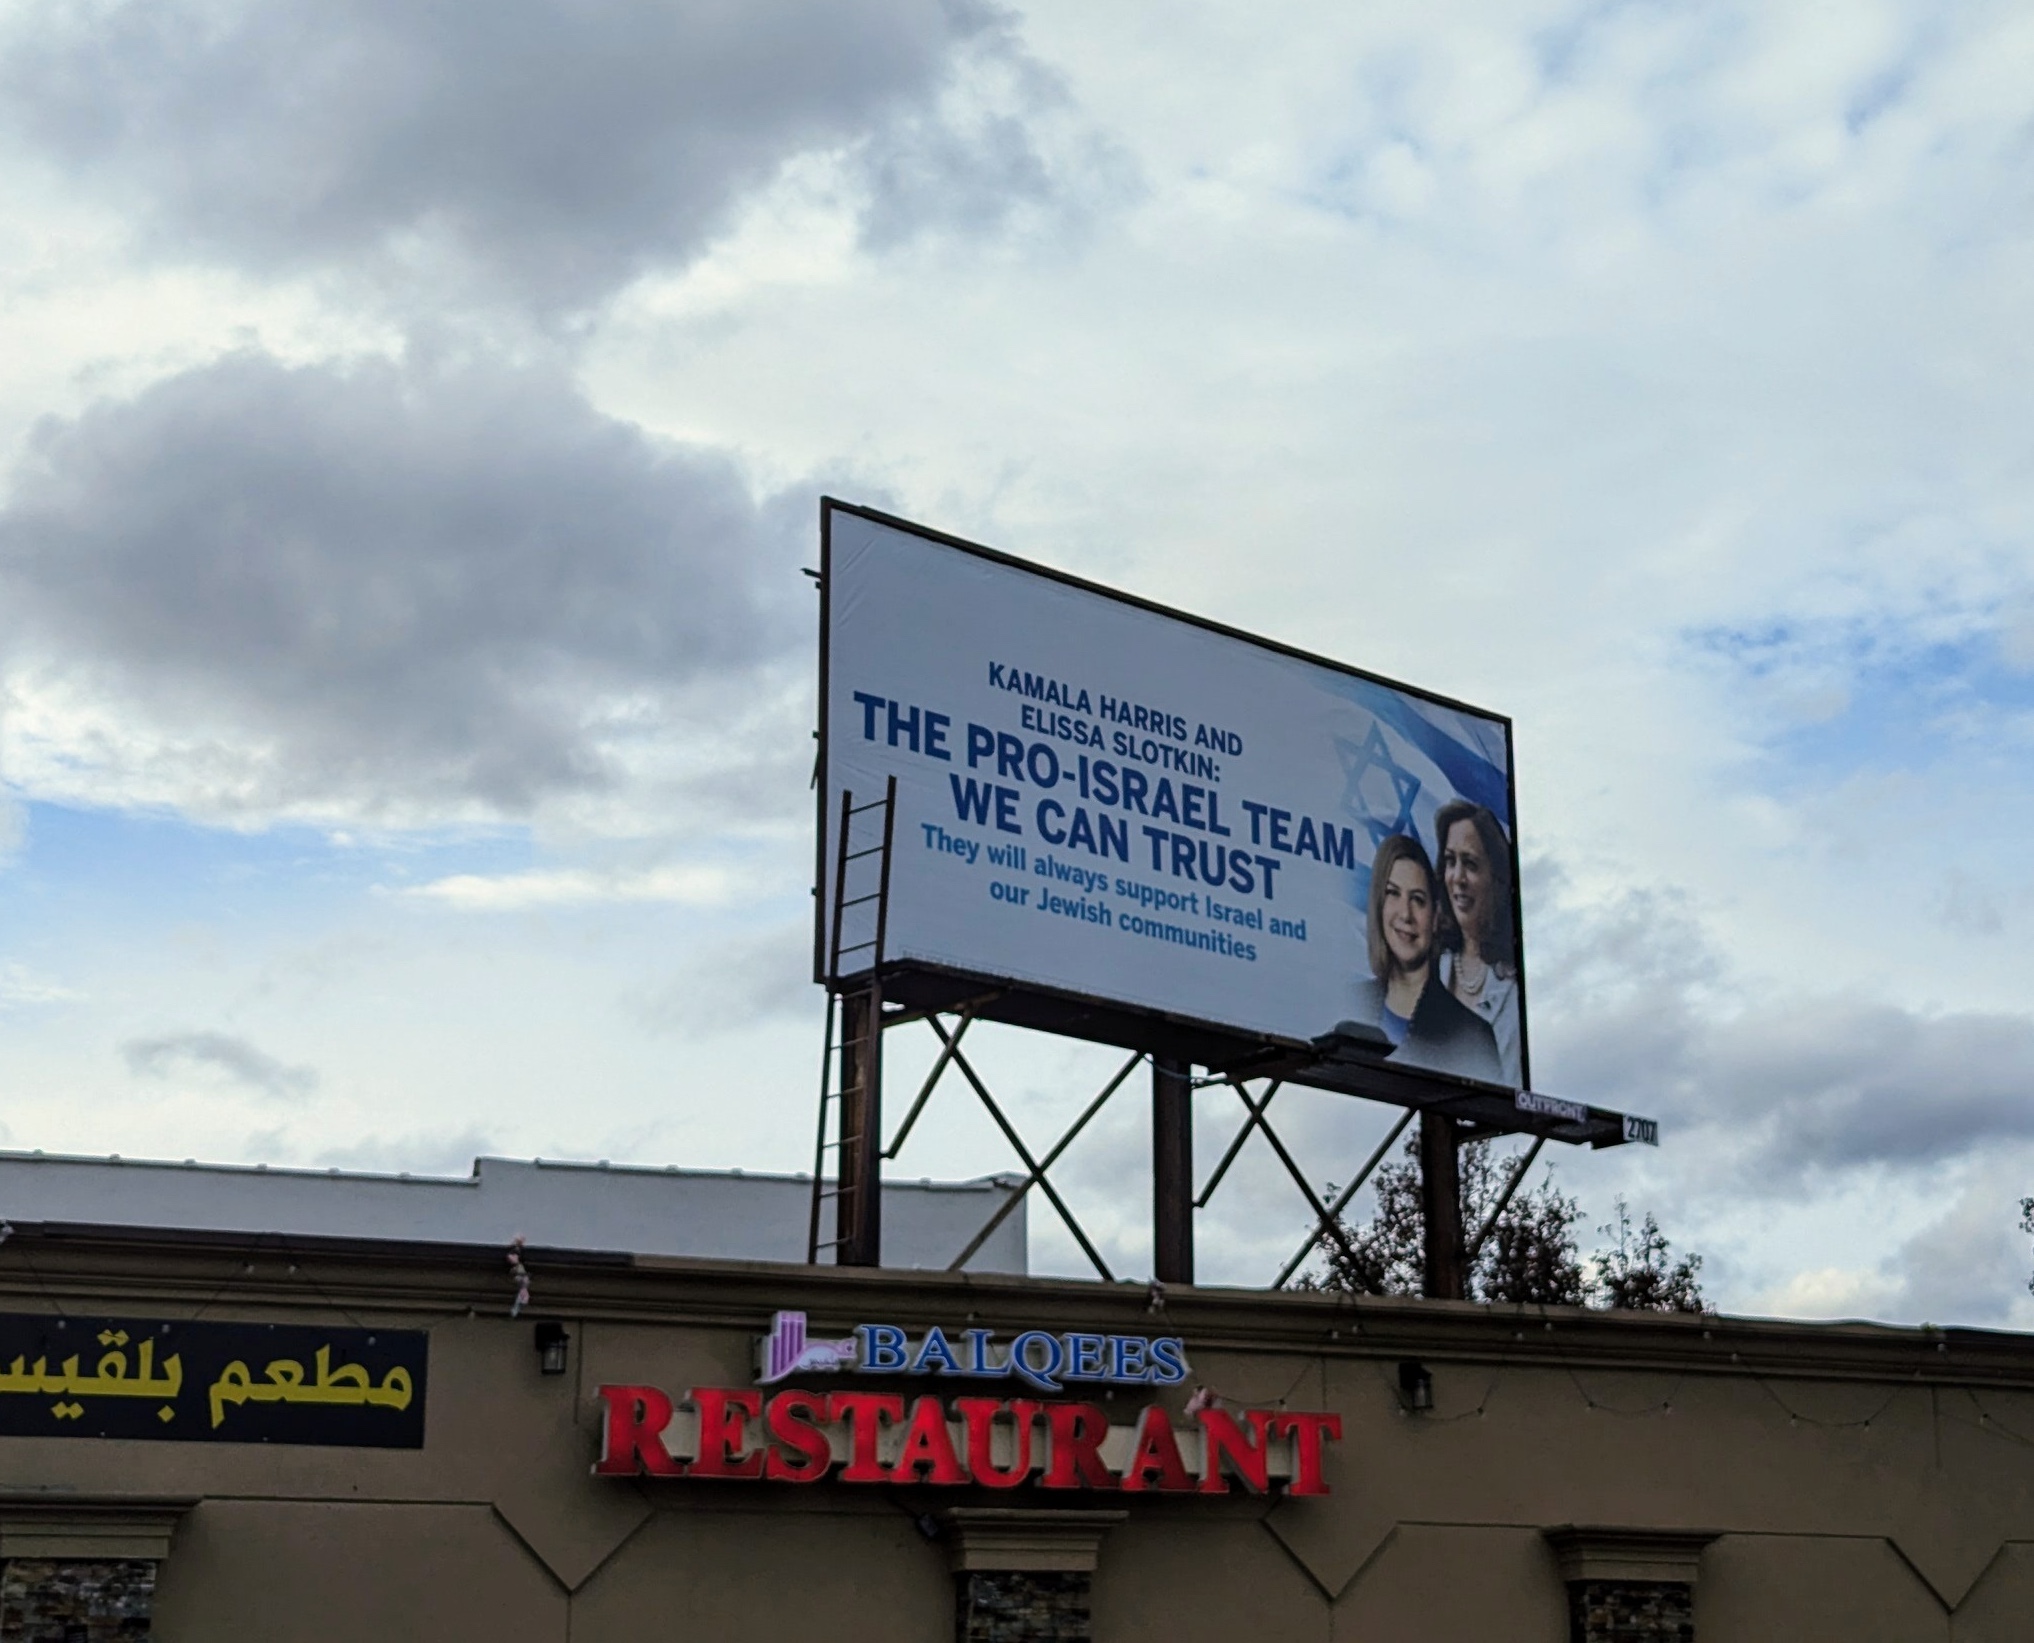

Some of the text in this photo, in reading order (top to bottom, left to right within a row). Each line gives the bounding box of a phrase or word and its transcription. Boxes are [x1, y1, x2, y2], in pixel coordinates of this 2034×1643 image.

[988, 662, 1243, 756] KAMALA HARRIS AND
[1020, 705, 1221, 782] ELISSA SLOTKIN:
[853, 691, 1356, 870] THE PRO-ISRAEL TEAM
[921, 823, 1307, 941] They will always support Israel and
[949, 774, 1281, 900] WE CAN TRUST
[989, 879, 1257, 961] our Jewish communities
[1627, 1117, 1657, 1144] 2707
[209, 1343, 413, 1430] مطعم
[860, 1325, 1187, 1390] BALQEES
[598, 1385, 1342, 1496] RESTAURANT
